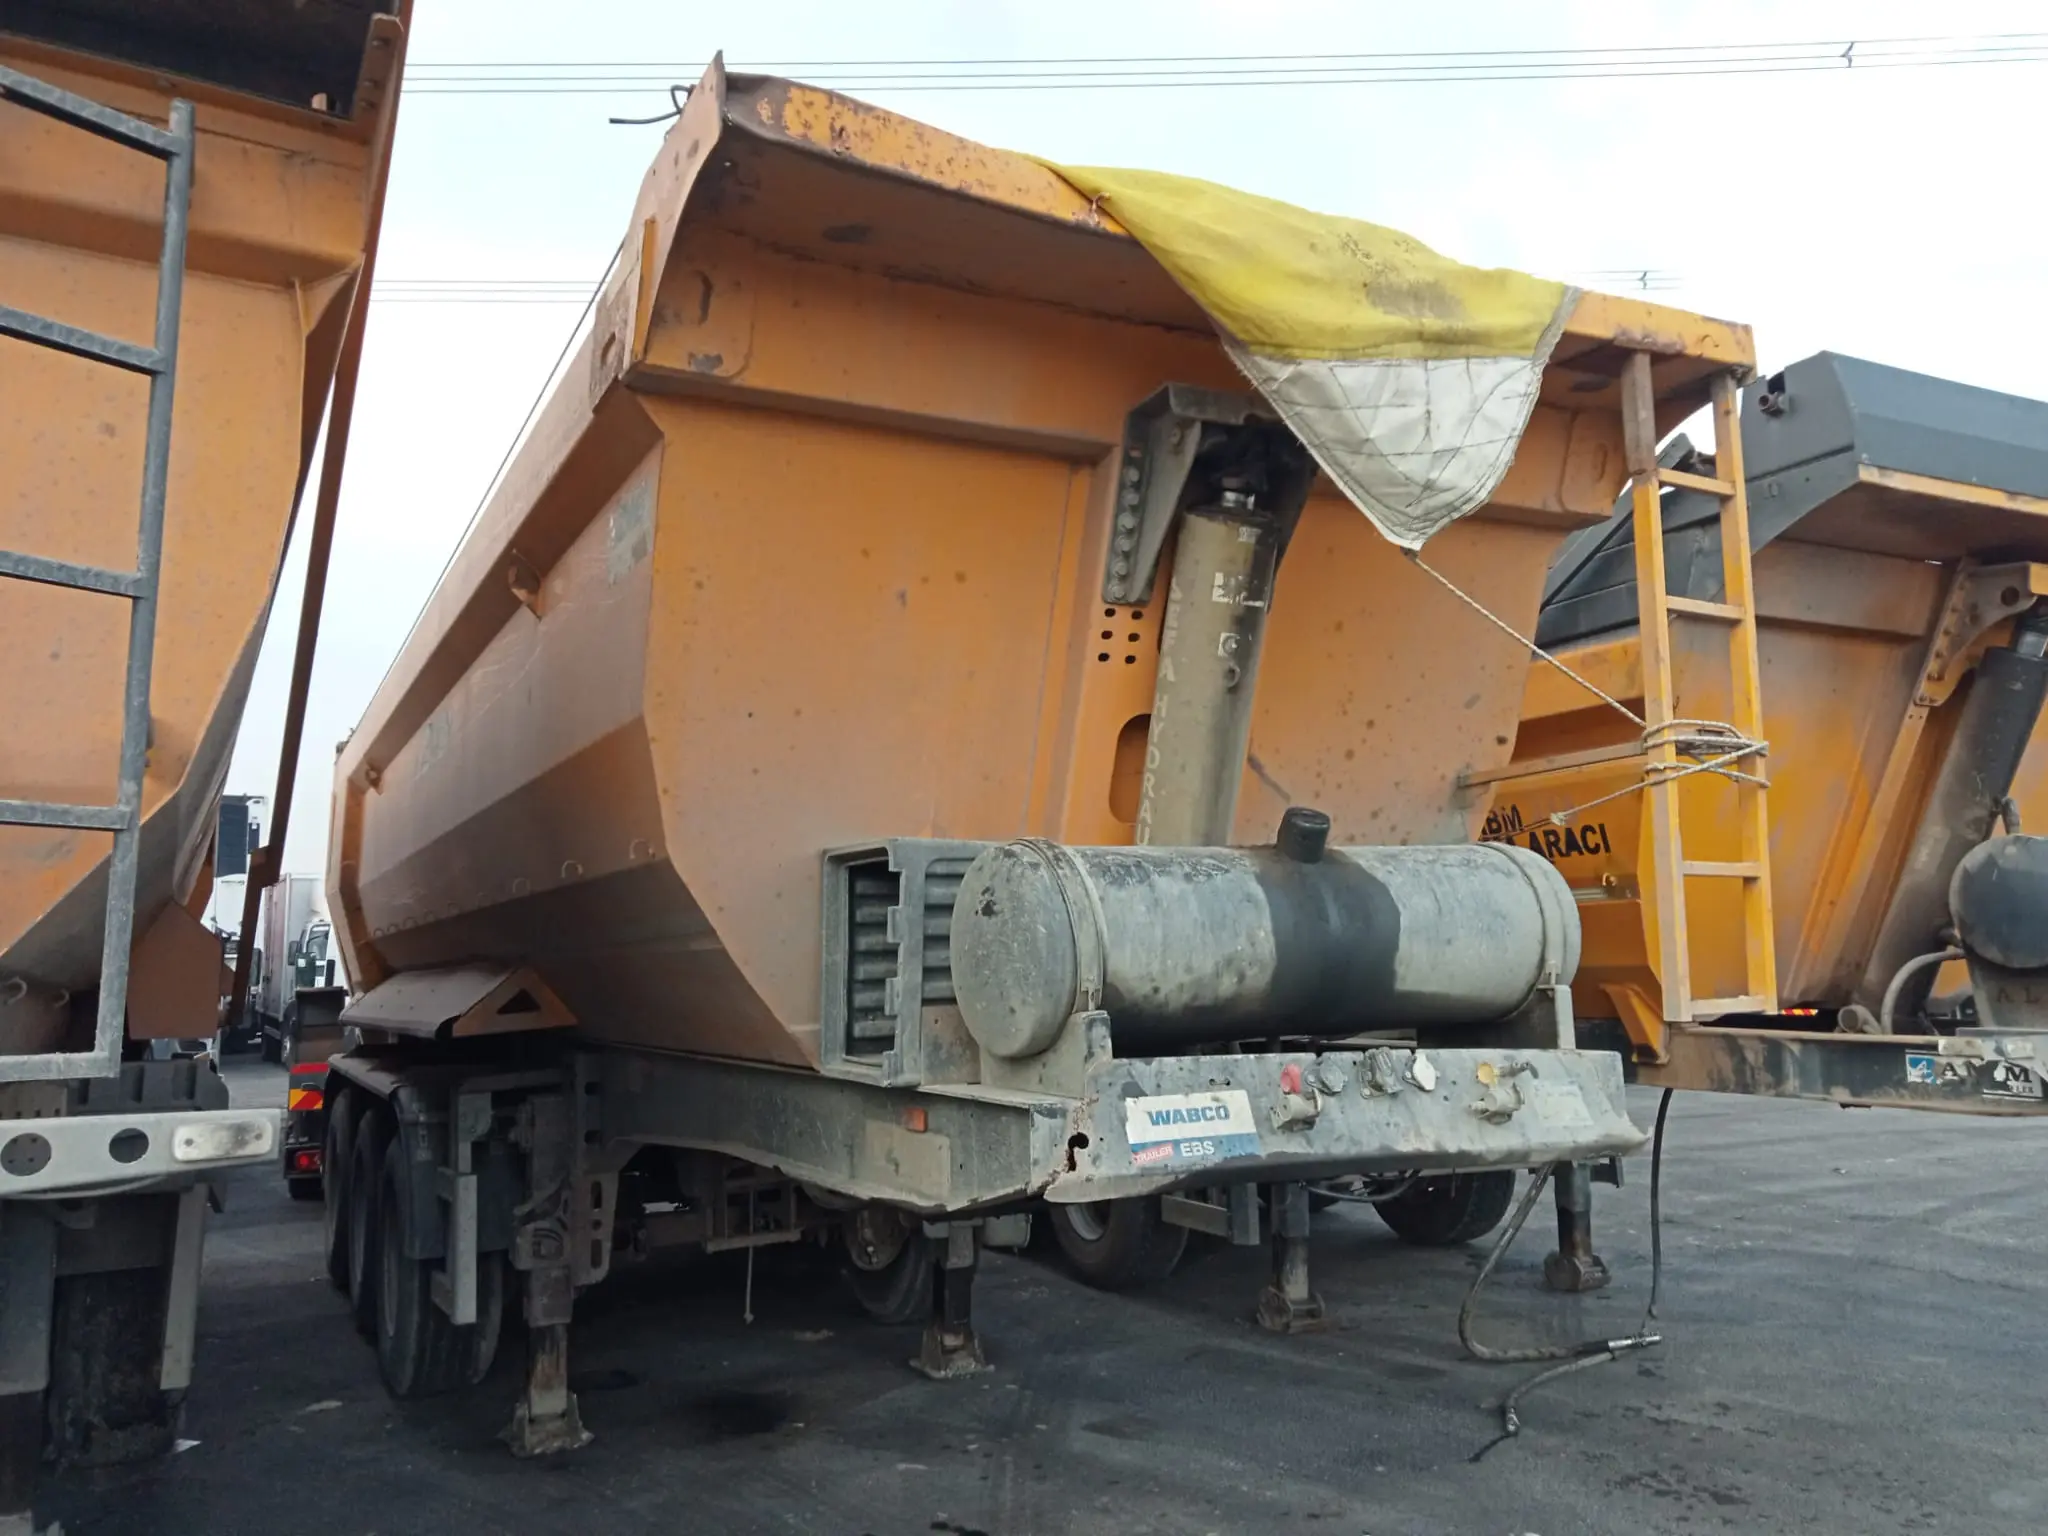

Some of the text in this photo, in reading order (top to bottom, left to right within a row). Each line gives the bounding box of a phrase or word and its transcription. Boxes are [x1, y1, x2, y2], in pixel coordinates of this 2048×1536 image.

[1528, 824, 1612, 861] ARACI
[1148, 1105, 1230, 1126] WABCO
[1180, 1140, 1215, 1157] EBS
